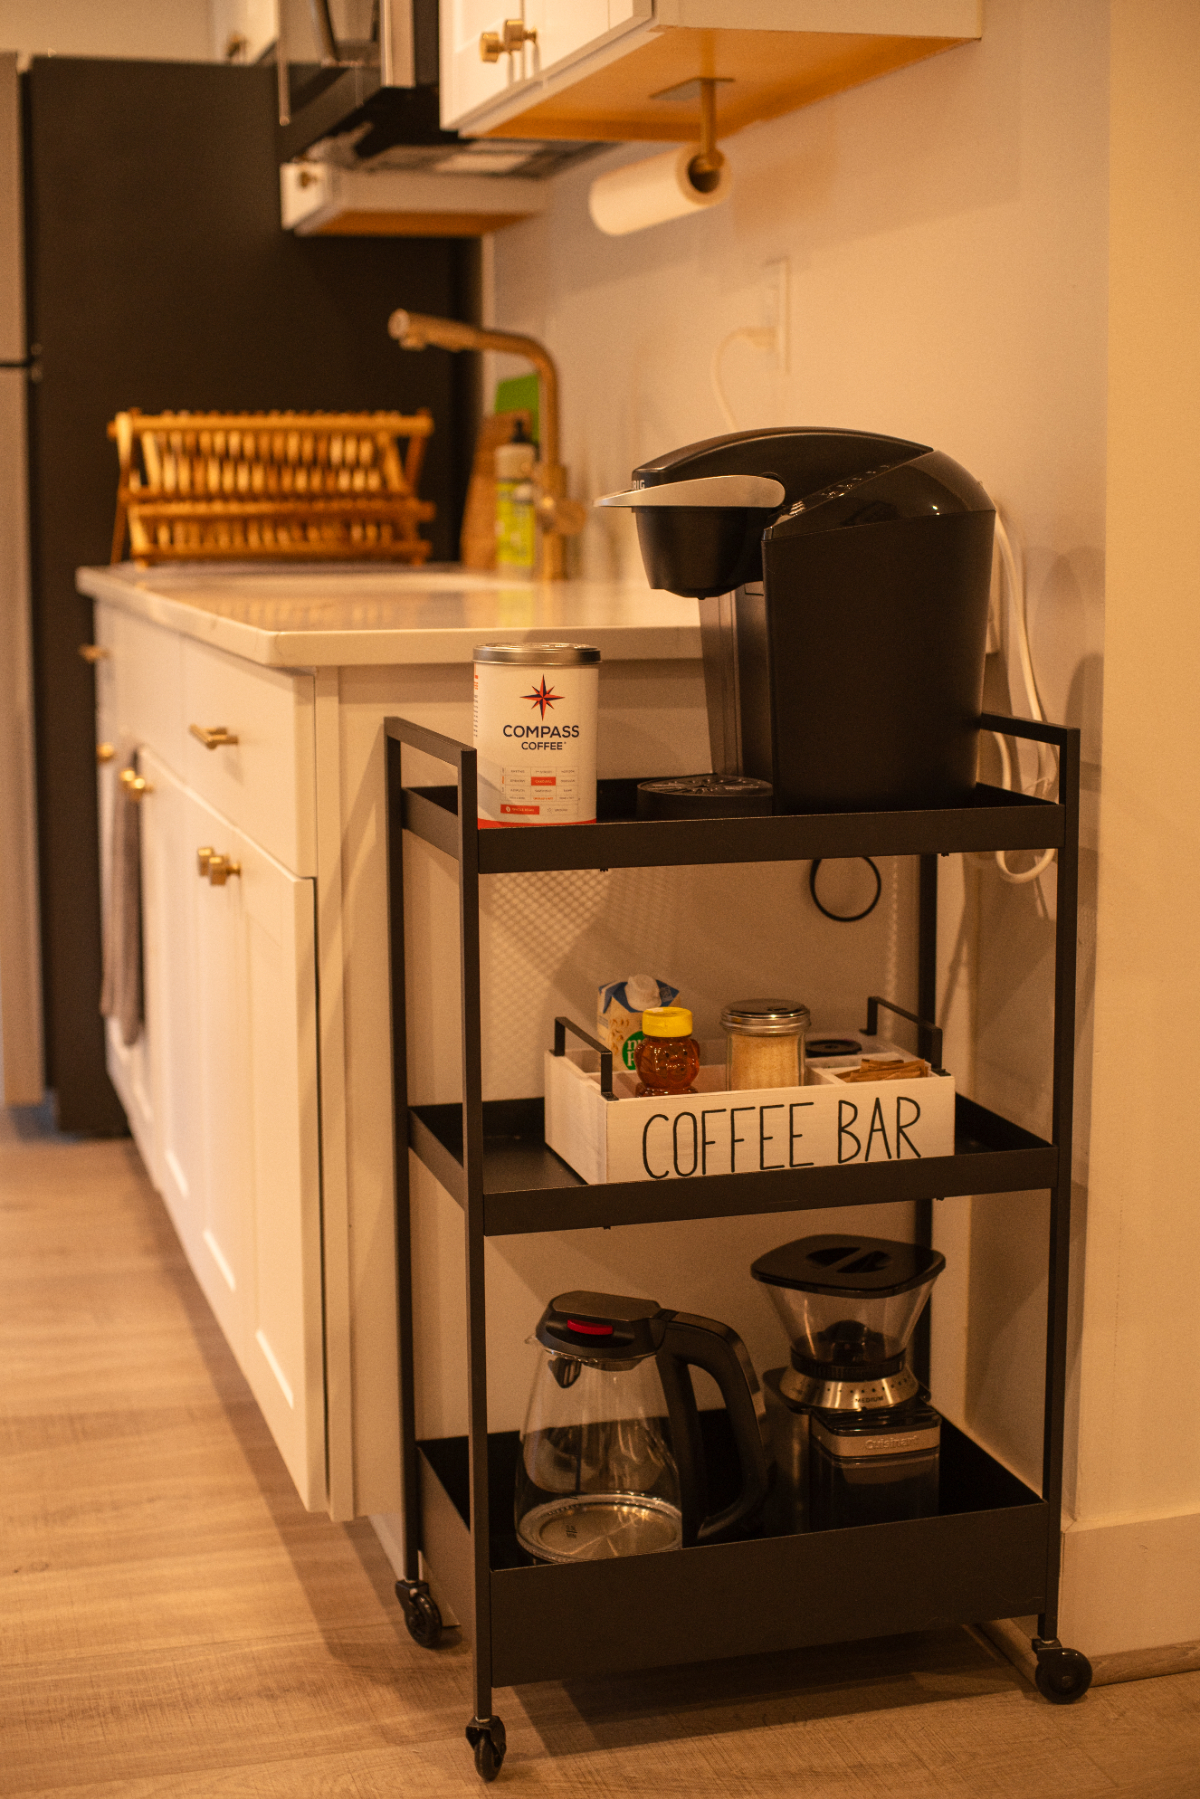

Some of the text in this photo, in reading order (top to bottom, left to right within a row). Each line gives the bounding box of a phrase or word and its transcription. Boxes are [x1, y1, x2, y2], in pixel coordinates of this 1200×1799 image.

[503, 724, 580, 739] COMPASS
[521, 741, 563, 751] COFFEE
[642, 1096, 922, 1179] COFFEE BAR
[855, 1395, 884, 1403] MEDIUM
[865, 1435, 918, 1450] Cuisinart
